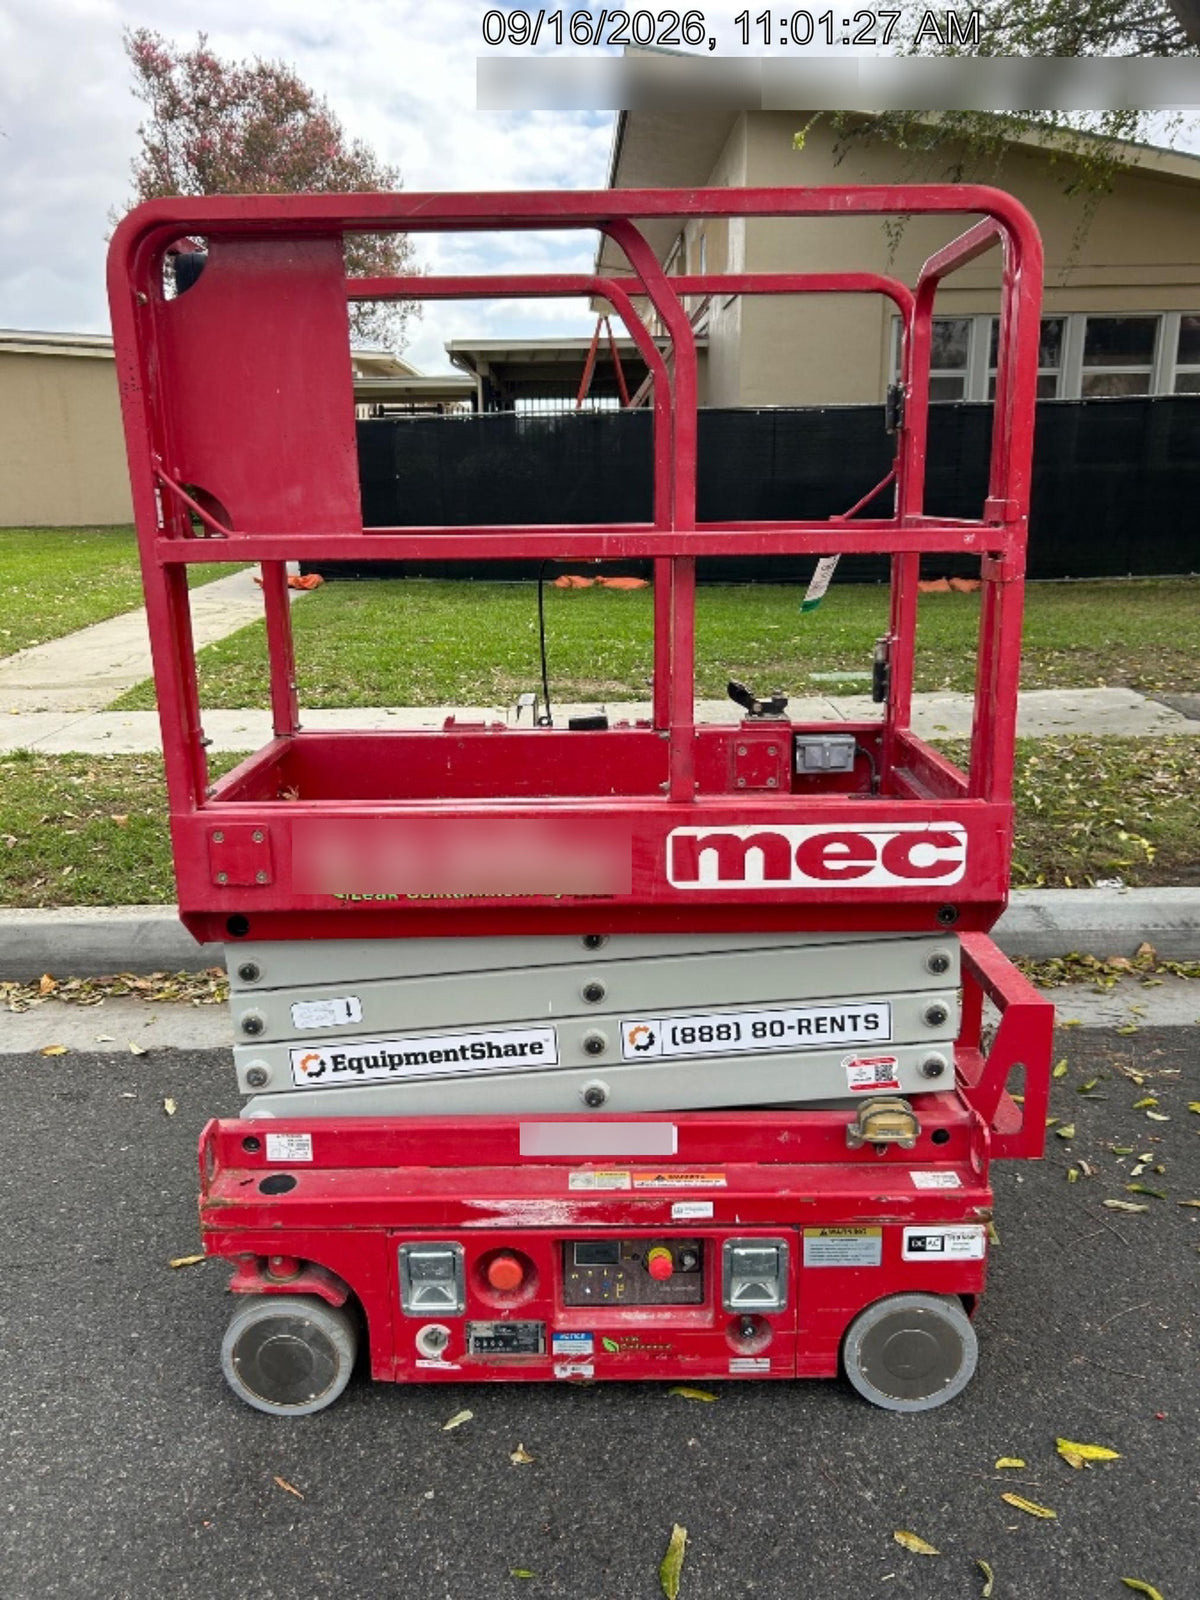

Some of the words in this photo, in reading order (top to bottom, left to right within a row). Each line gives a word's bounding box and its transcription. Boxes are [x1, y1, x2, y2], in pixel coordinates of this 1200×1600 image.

[672, 830, 964, 882] mec
[671, 1022, 742, 1046] (888)
[751, 1013, 880, 1039] 80-RENTS
[330, 1040, 544, 1074] EquipmentShare
